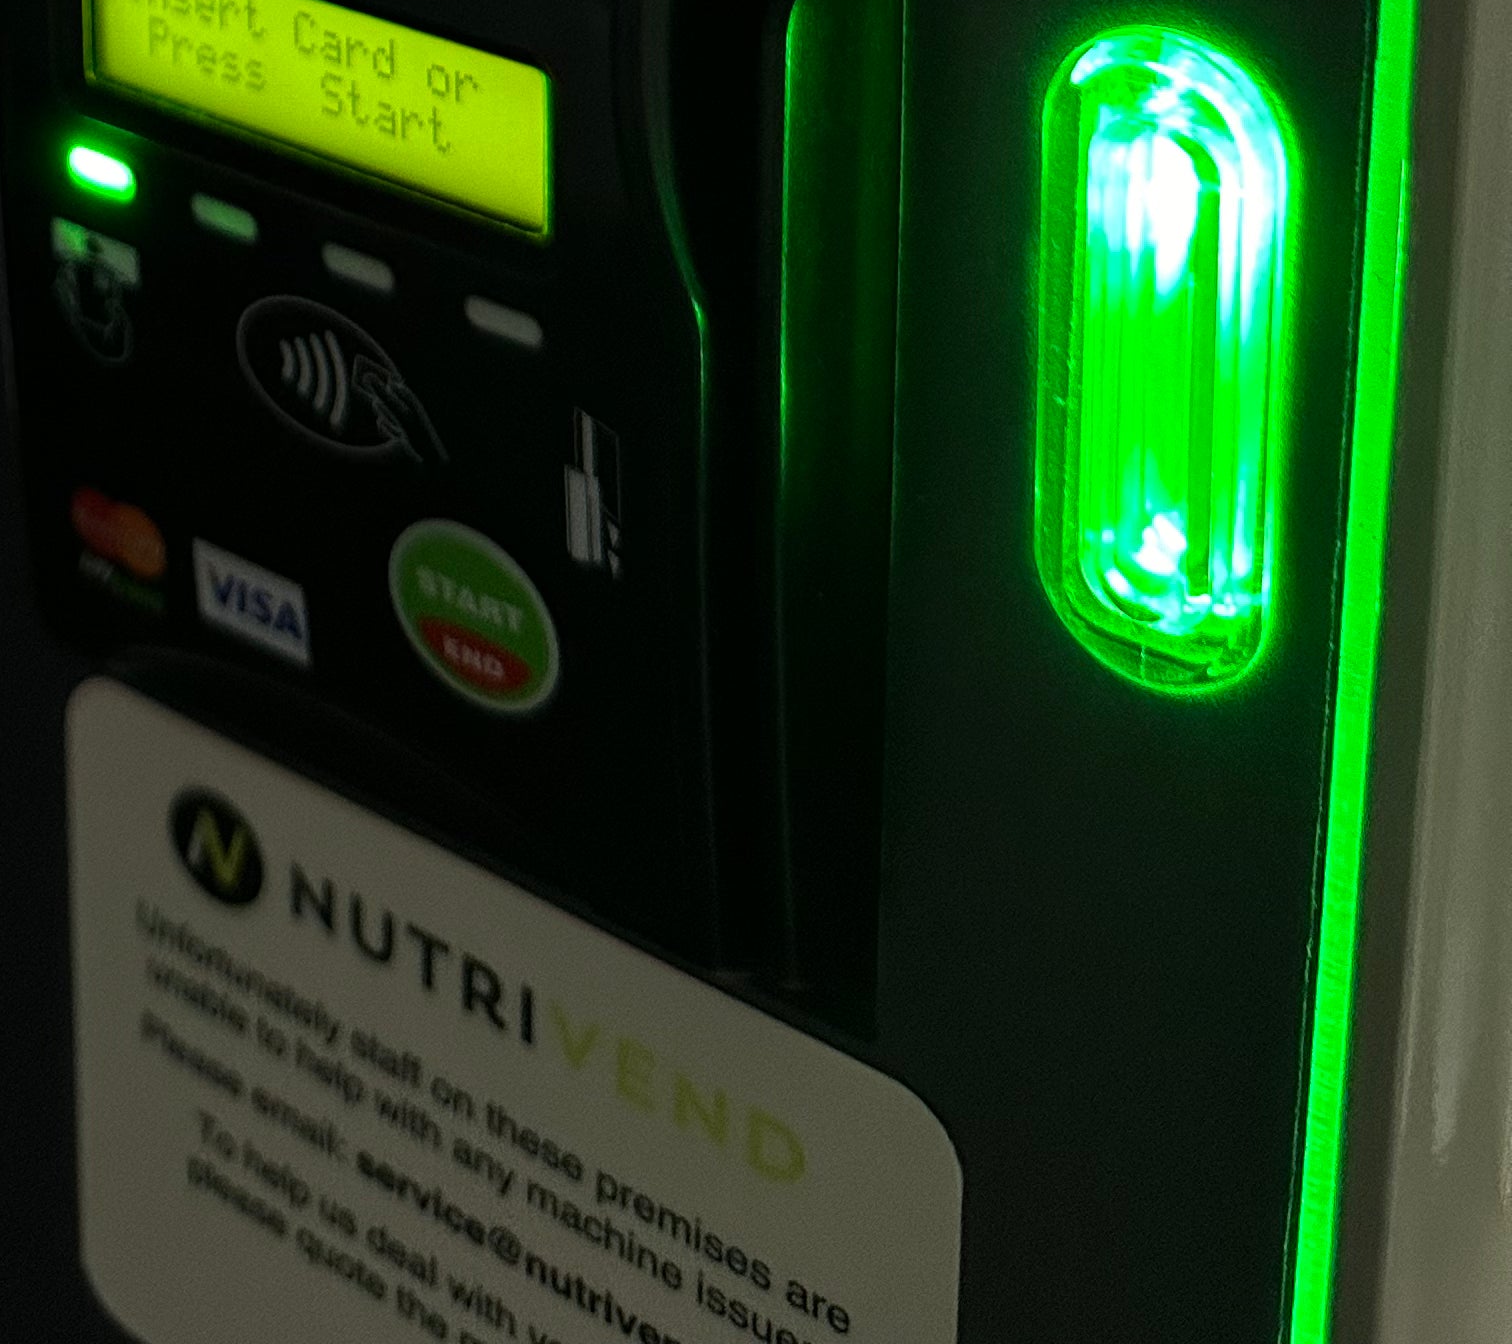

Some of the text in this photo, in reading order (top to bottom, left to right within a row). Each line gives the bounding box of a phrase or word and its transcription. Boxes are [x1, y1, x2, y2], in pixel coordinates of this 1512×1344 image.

[147, 15, 453, 155] Press Start
[292, 10, 397, 80] Card
[426, 61, 481, 106] or
[208, 563, 302, 640] VISA
[414, 564, 524, 633] START
[441, 634, 506, 682] END
[139, 1006, 245, 1098] Please
[289, 862, 806, 1182] NUTRIVEND
[137, 898, 851, 1335] Unfortunately staff on these premises are
[145, 957, 812, 1344] unable to help with any machine issue
[187, 1155, 449, 1340] please quote the
[198, 1108, 518, 1339] To help us deal with
